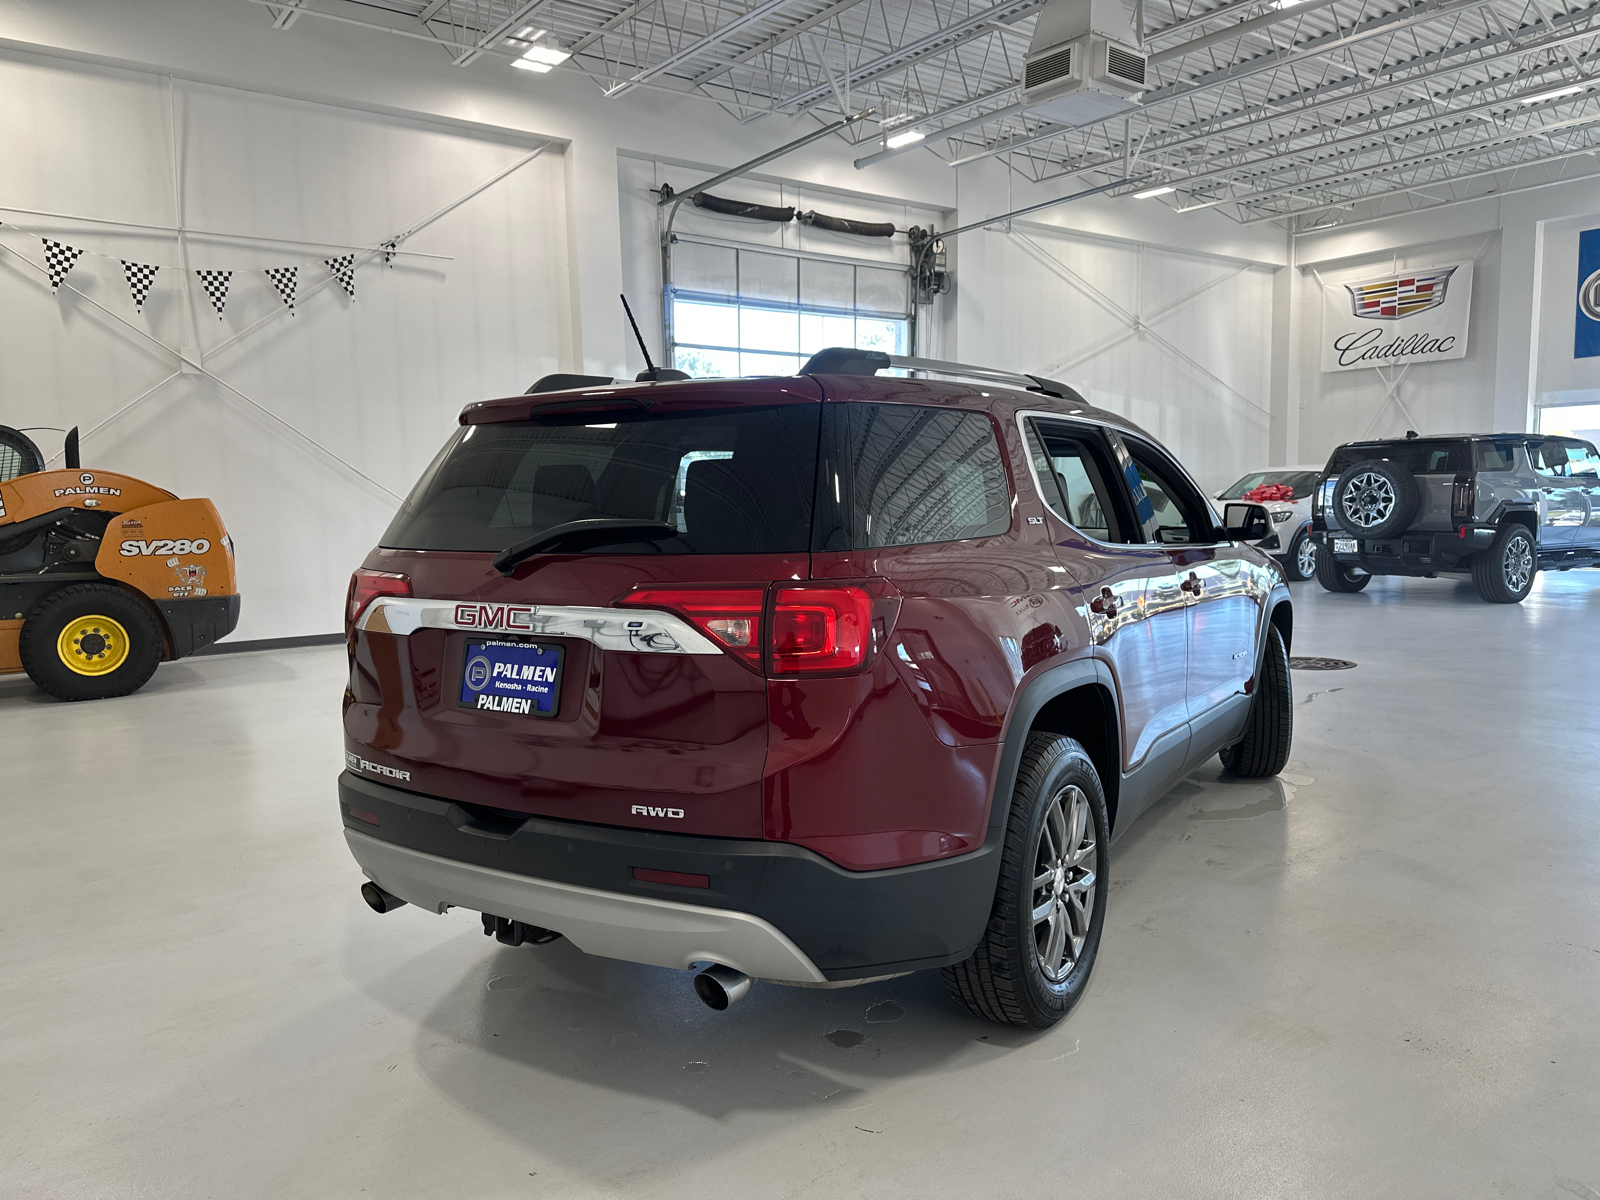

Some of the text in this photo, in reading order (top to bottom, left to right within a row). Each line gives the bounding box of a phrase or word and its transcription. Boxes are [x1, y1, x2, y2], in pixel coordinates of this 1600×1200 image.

[1334, 328, 1456, 366] Cadillac
[54, 486, 121, 497] PALMEN
[1027, 517, 1043, 525] SLT
[119, 538, 211, 557] SV280
[454, 603, 534, 632] GMC
[486, 640, 538, 649] palmen.com
[492, 662, 557, 682] PALMEN
[495, 680, 522, 690] Kenosha
[526, 684, 549, 693] Racine
[477, 694, 532, 714] PALMEN
[361, 760, 411, 781] ACADIA
[631, 804, 685, 819] AWD
